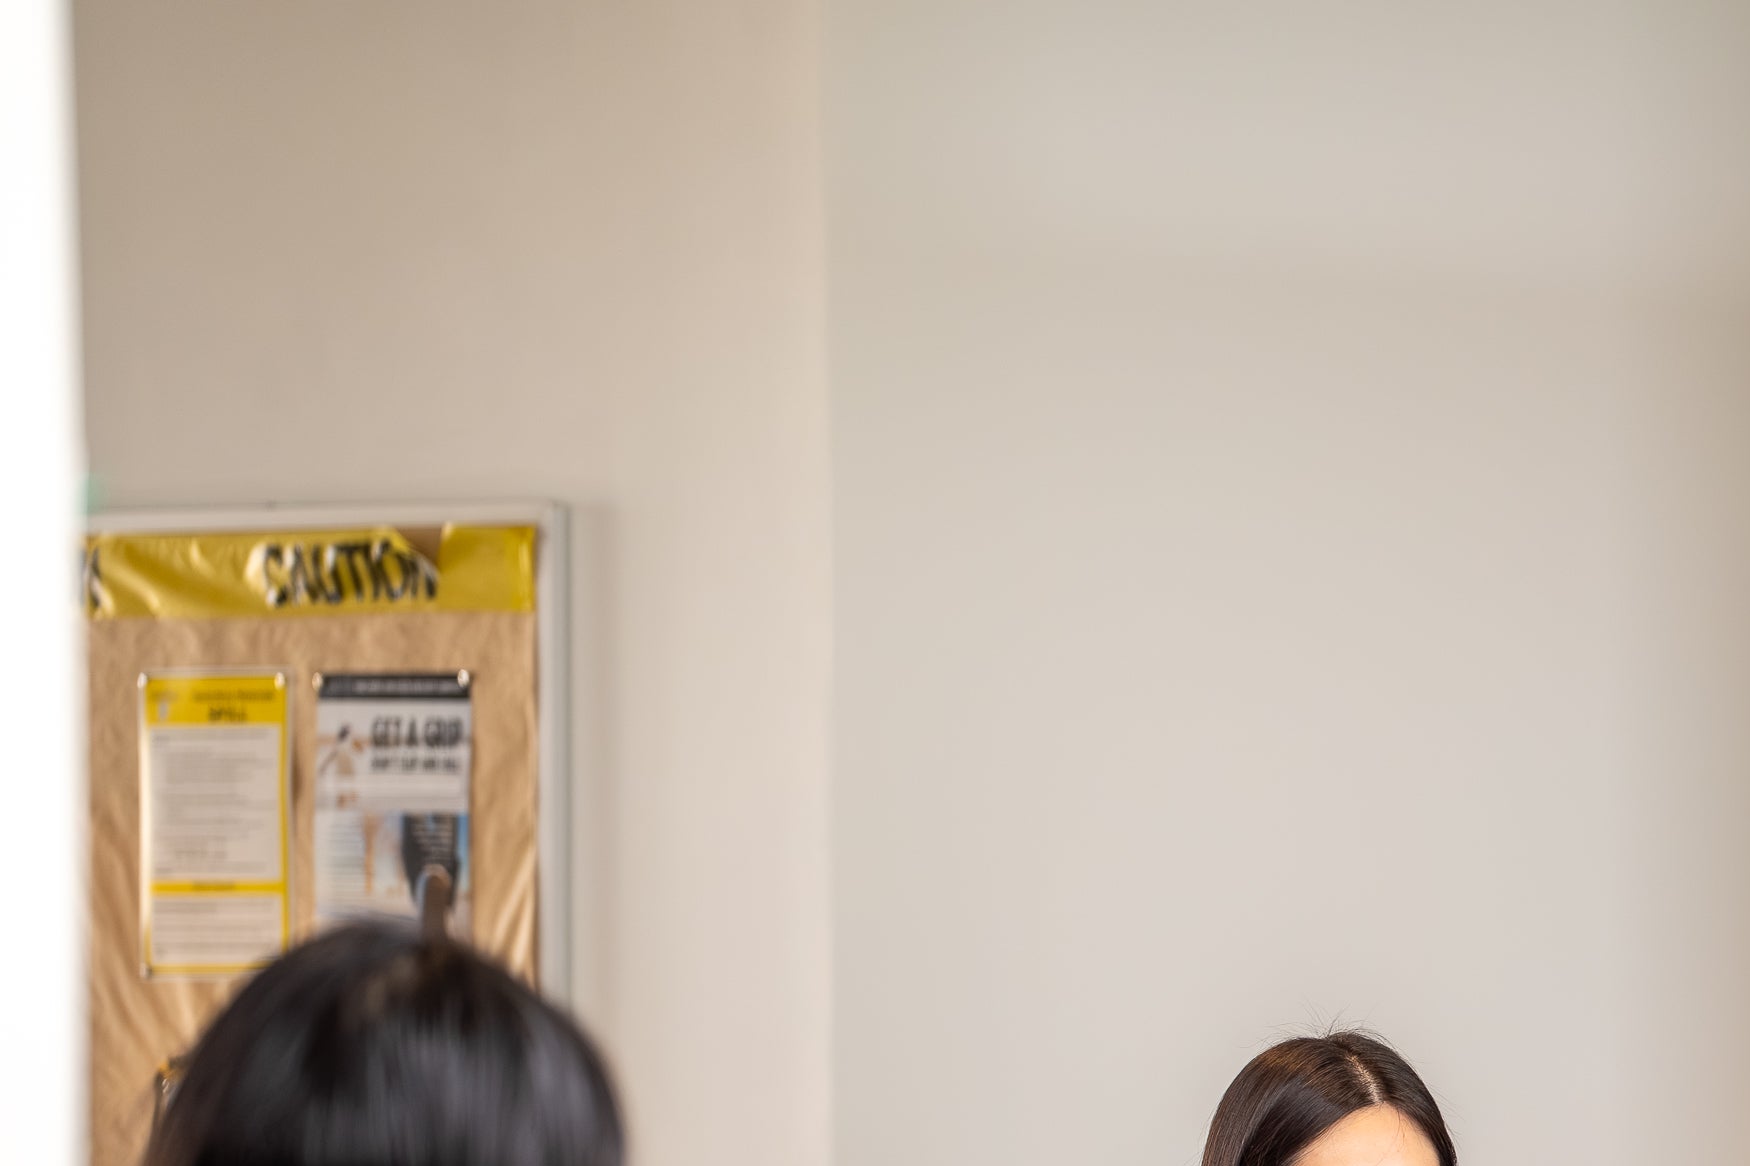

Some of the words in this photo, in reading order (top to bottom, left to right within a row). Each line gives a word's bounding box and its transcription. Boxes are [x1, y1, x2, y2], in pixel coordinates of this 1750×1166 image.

[264, 539, 437, 607] CAUTION
[373, 717, 401, 747] GET
[405, 717, 419, 747] A
[425, 716, 464, 747] GRIP
